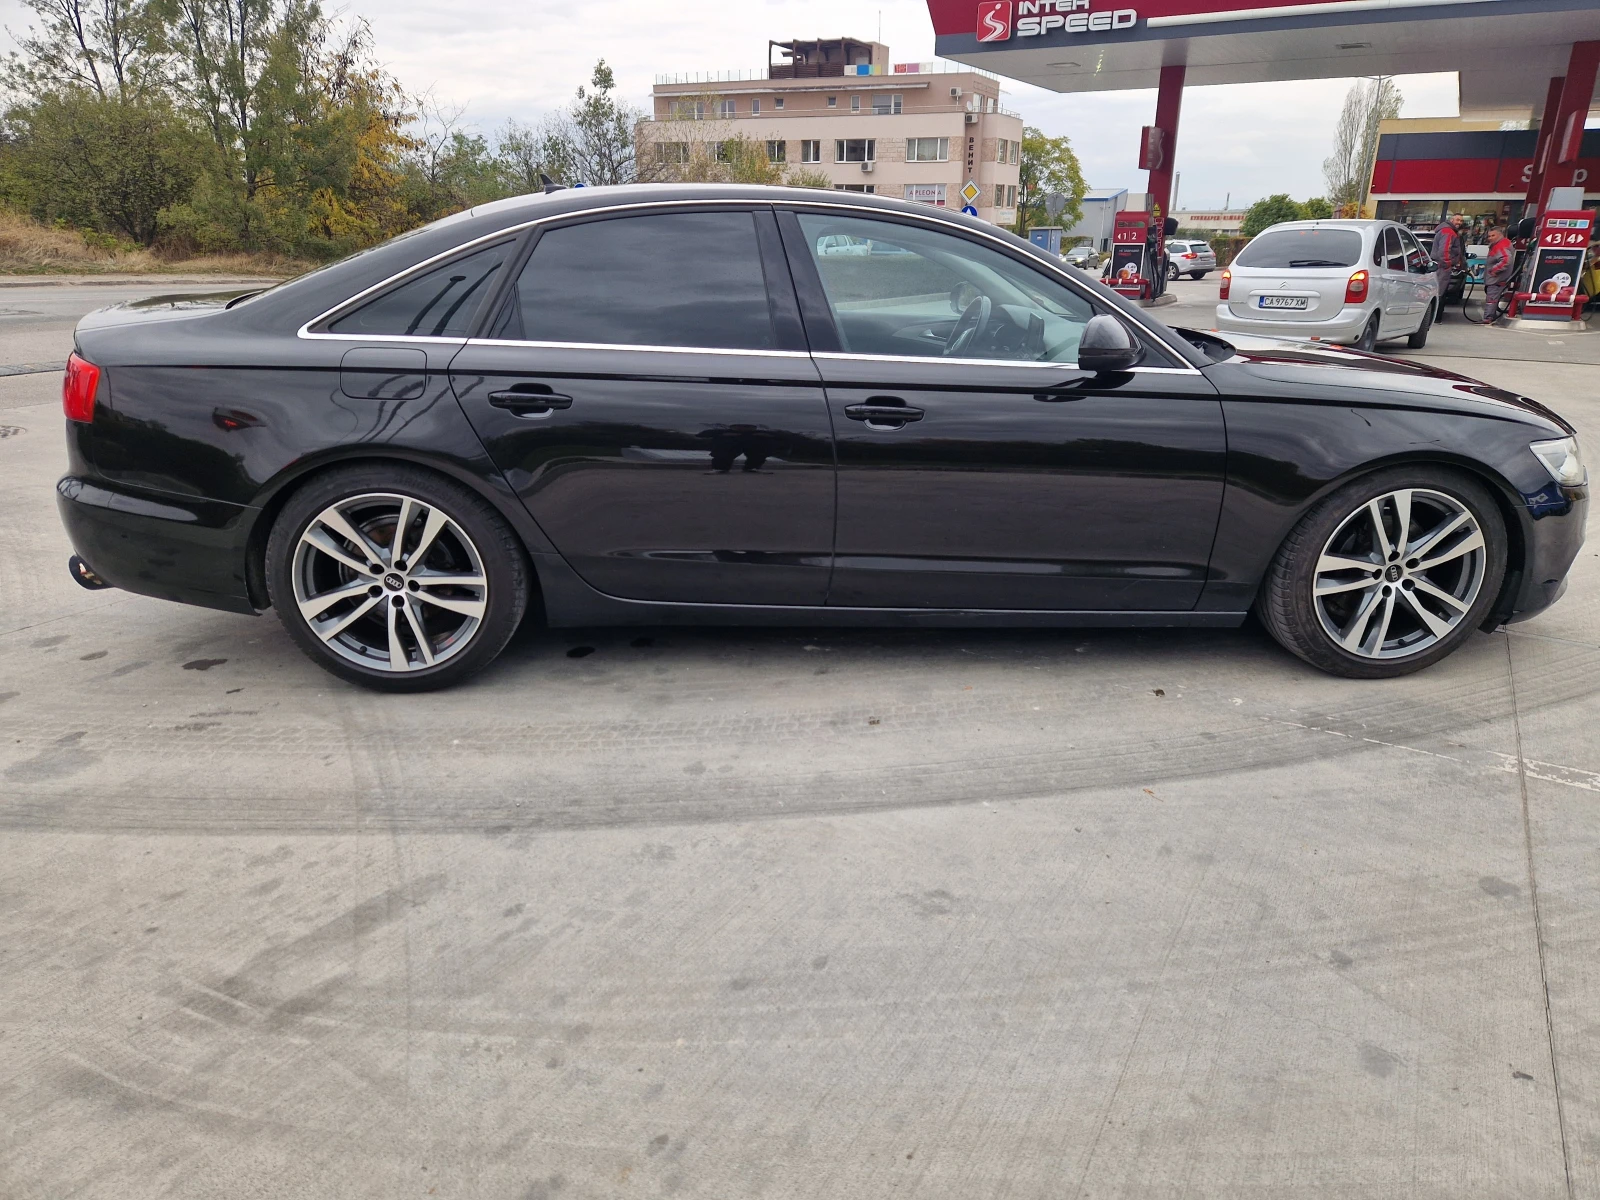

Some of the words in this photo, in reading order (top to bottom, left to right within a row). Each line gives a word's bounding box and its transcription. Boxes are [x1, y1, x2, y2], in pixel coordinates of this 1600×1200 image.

[1018, 0, 1090, 15] INTER
[1017, 9, 1137, 37] SPEED
[1131, 232, 1137, 240] 2
[1553, 233, 1562, 244] 3
[1566, 233, 1576, 244] 4
[1264, 298, 1274, 306] CA
[1275, 298, 1294, 306] 9767
